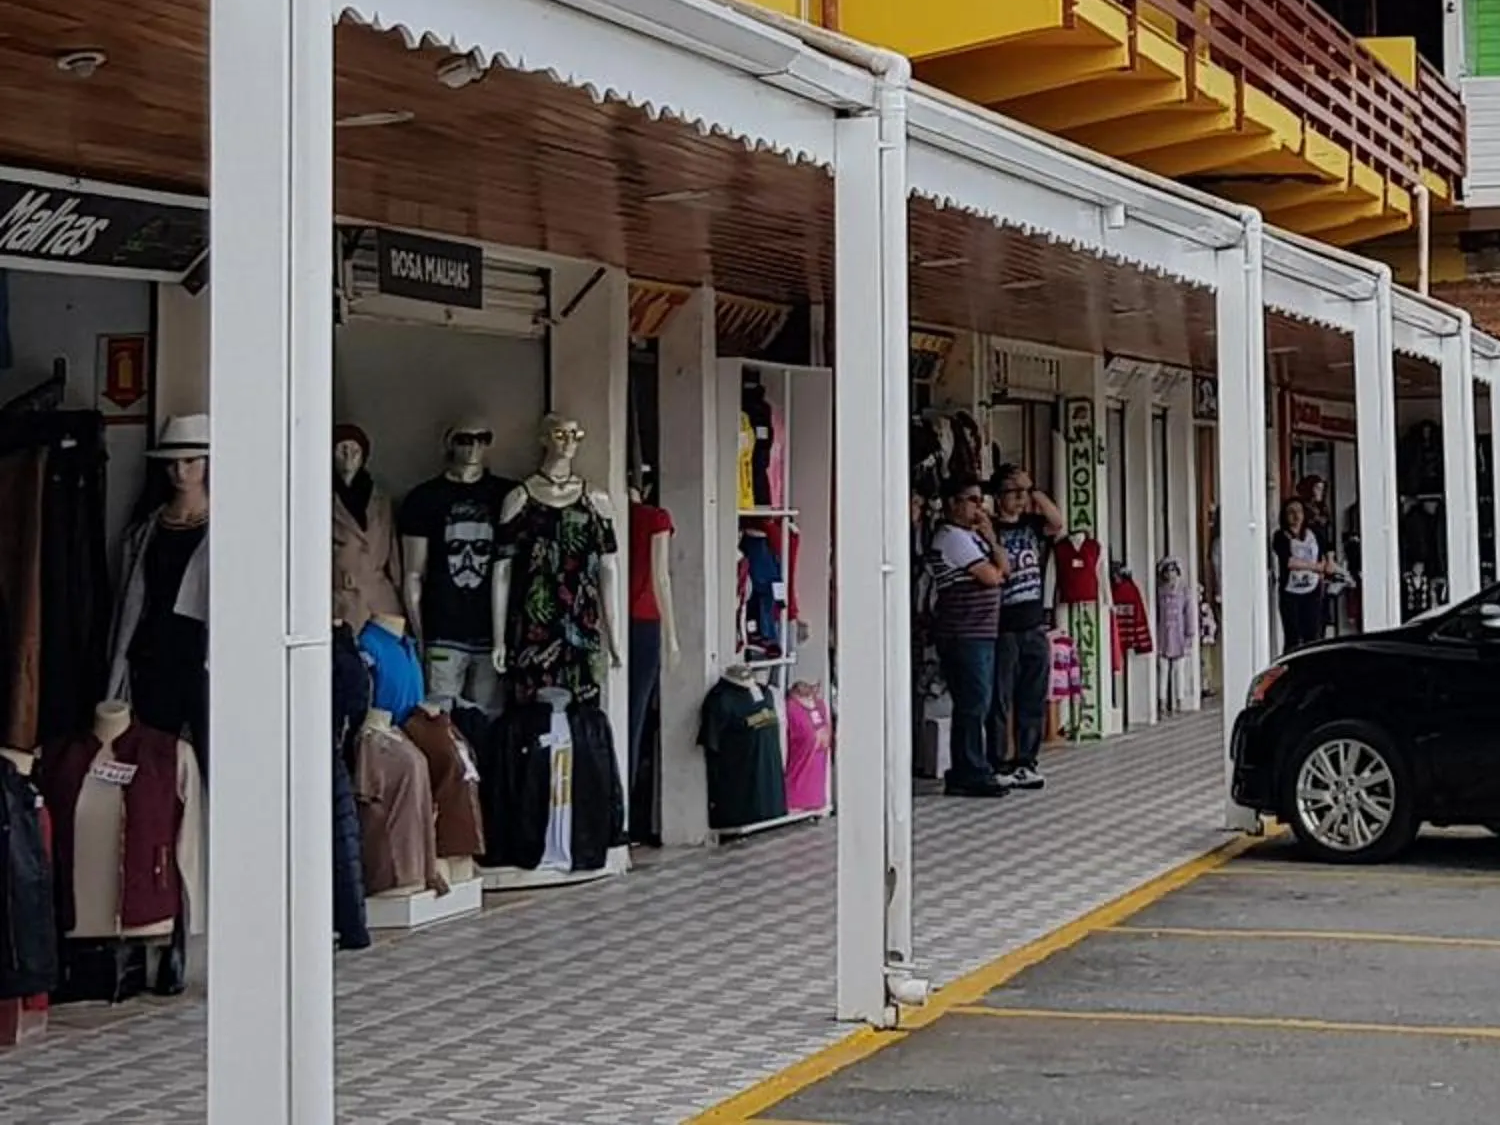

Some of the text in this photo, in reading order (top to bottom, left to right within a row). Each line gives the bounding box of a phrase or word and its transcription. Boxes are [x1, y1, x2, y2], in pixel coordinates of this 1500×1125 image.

[0, 189, 111, 256] Malhas
[390, 248, 470, 290] ROSA MALHAS
[1071, 447, 1092, 527] MODA
